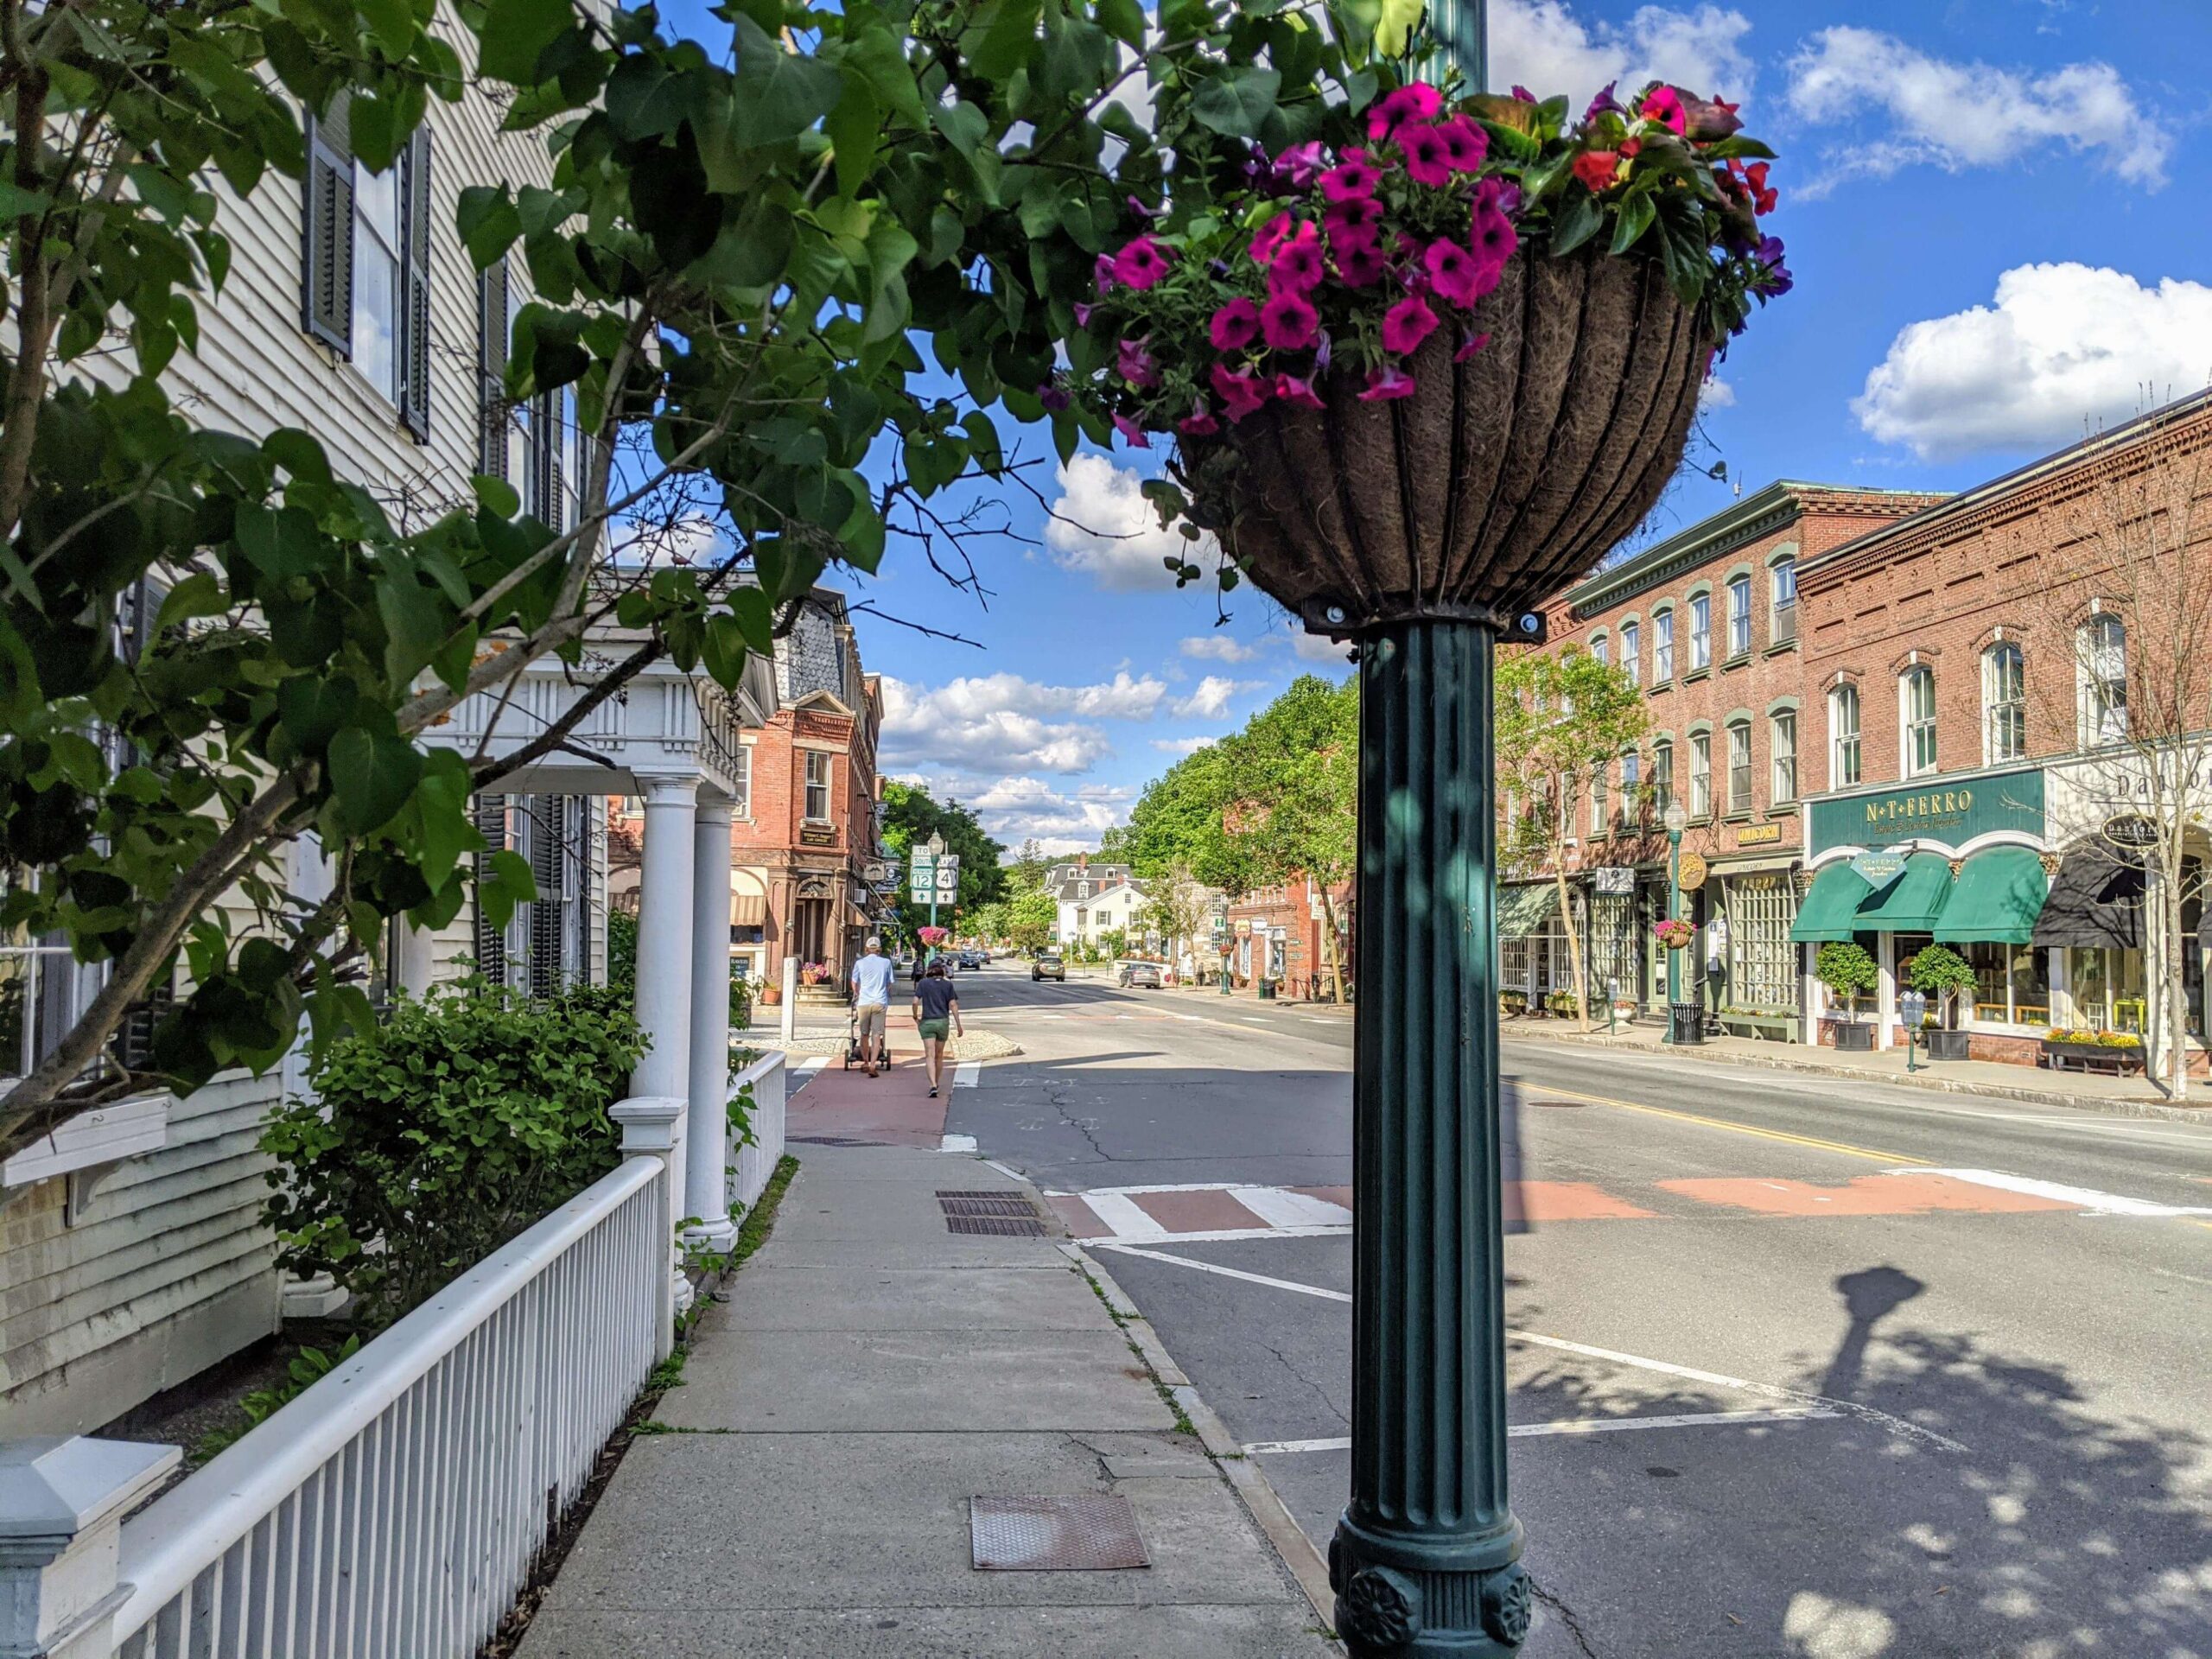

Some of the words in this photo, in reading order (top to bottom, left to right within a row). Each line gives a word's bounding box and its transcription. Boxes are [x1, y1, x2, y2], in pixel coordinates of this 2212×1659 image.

[1738, 826, 1777, 842] UNICORN
[917, 876, 929, 887] 12
[941, 874, 949, 884] 4
